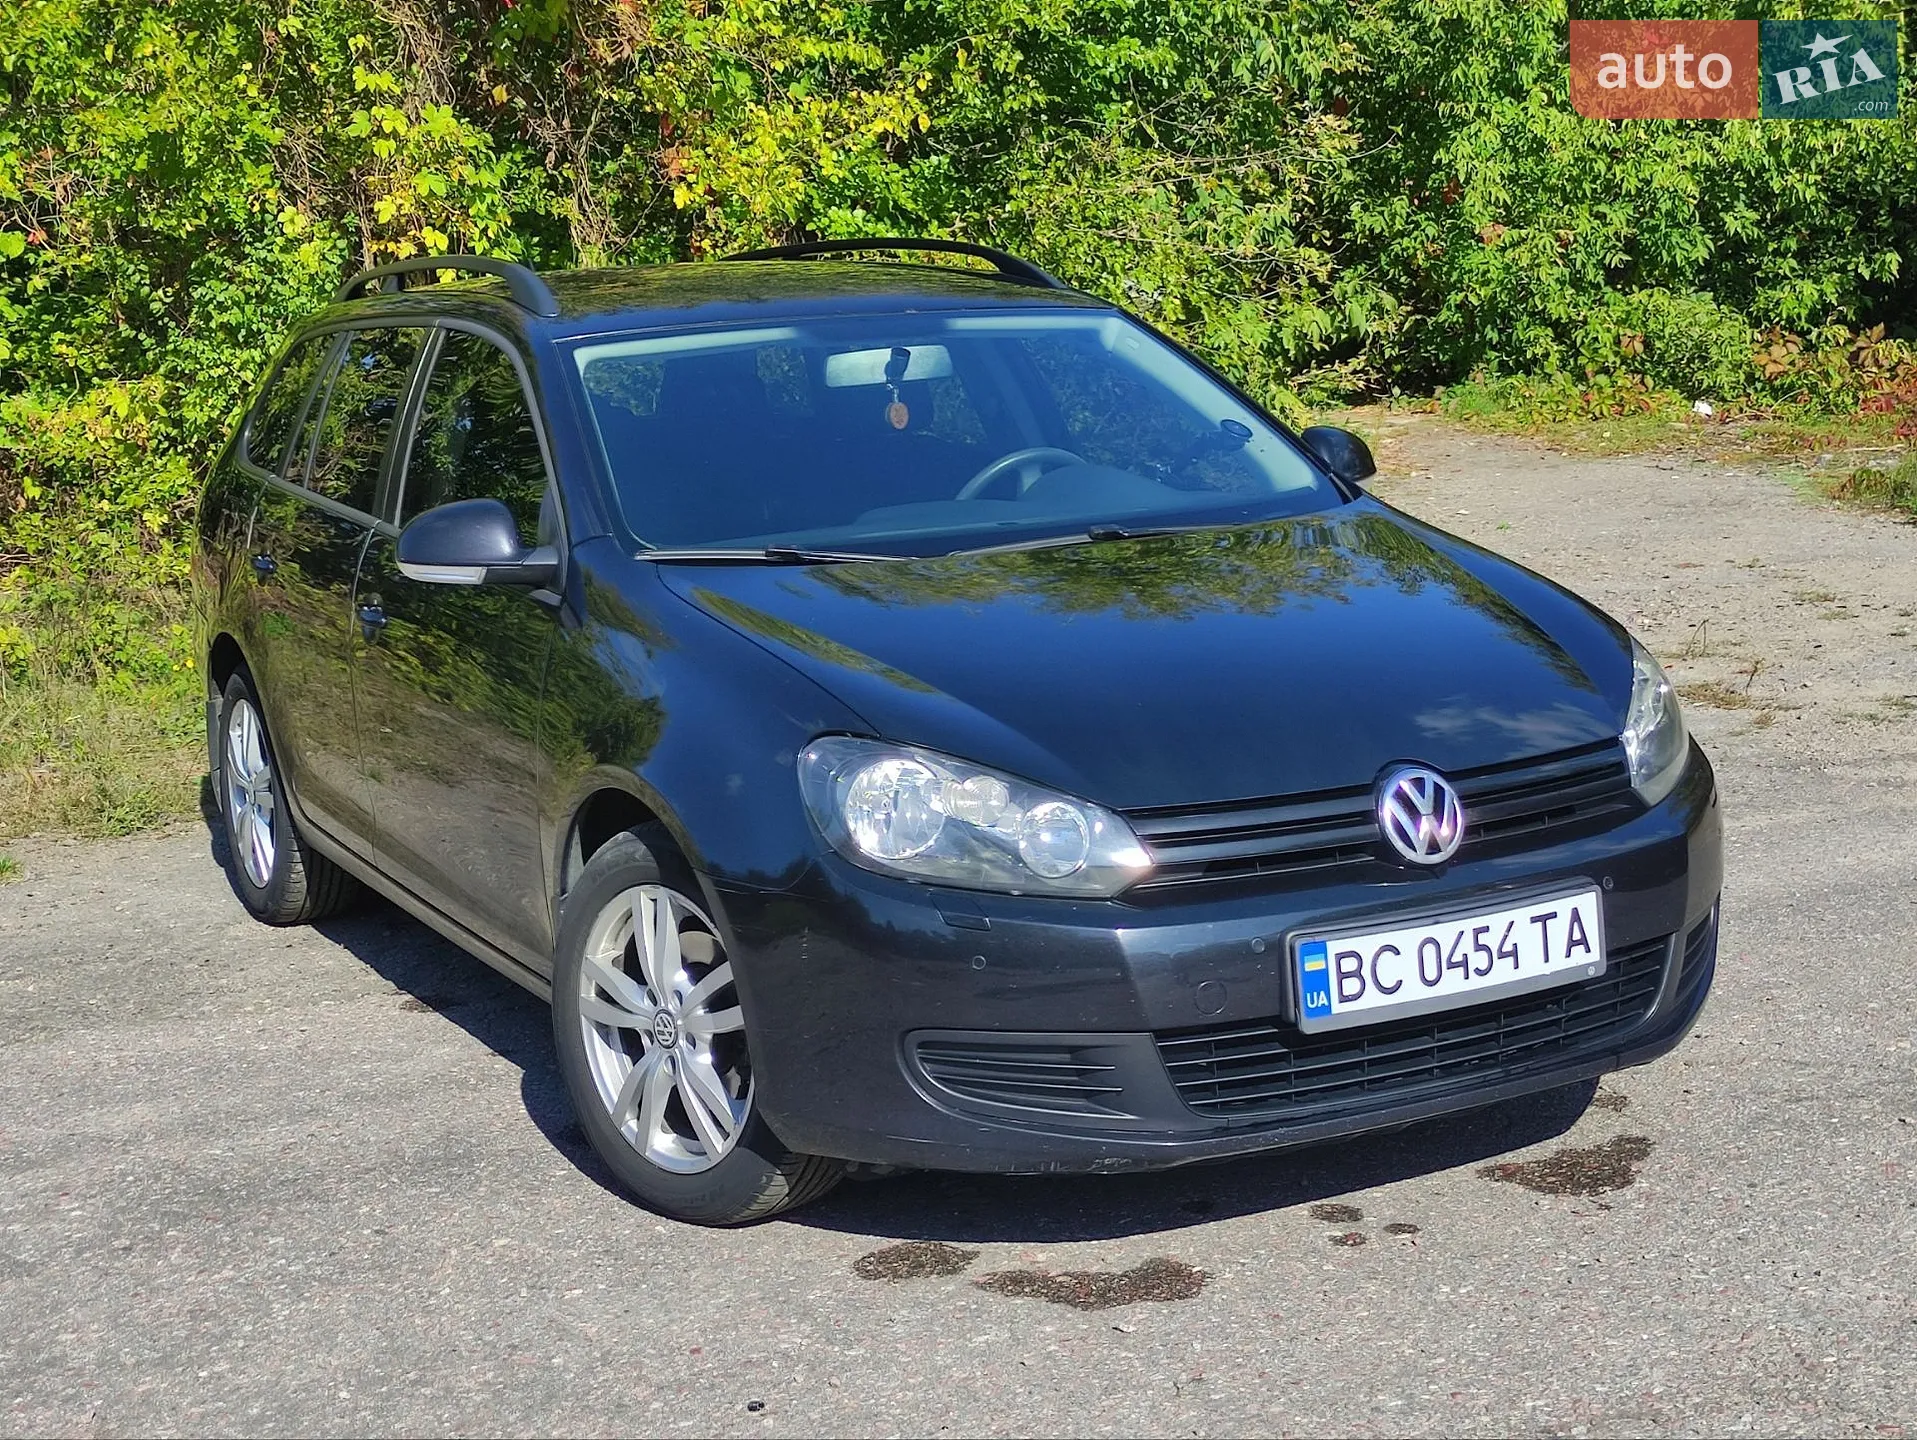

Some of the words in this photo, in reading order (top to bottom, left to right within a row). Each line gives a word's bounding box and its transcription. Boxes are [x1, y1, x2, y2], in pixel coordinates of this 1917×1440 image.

[1334, 945, 1403, 1003] BC
[1417, 920, 1519, 987] 0454
[1529, 907, 1591, 963] TA
[1306, 991, 1328, 1009] UA
